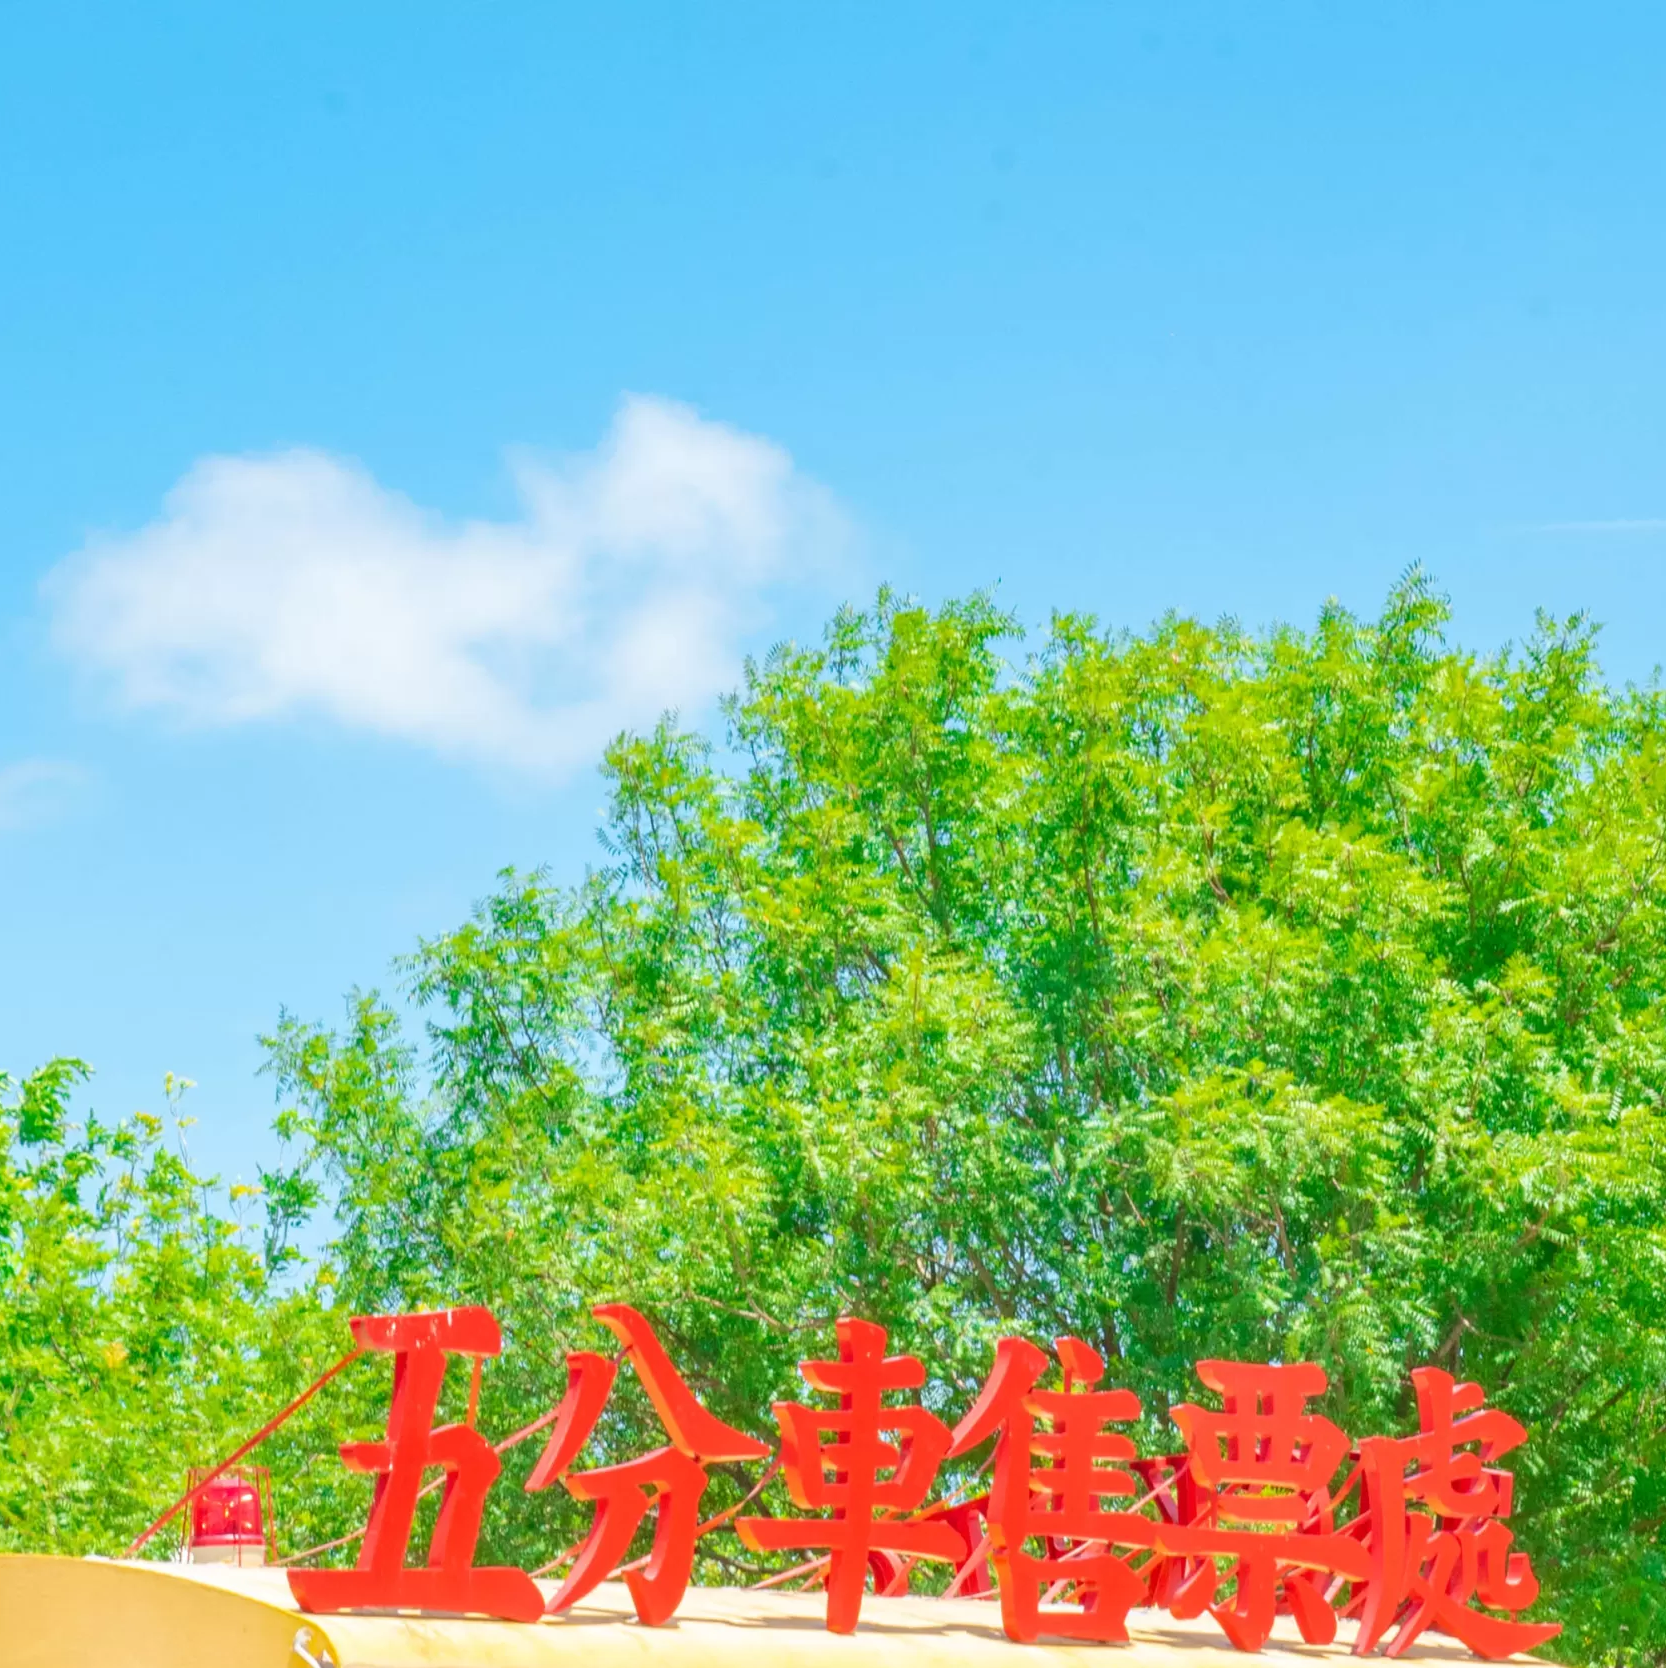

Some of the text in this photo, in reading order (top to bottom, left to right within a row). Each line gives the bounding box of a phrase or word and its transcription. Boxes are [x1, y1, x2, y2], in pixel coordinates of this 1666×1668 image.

[287, 1302, 1562, 1660] 五分車售票處
